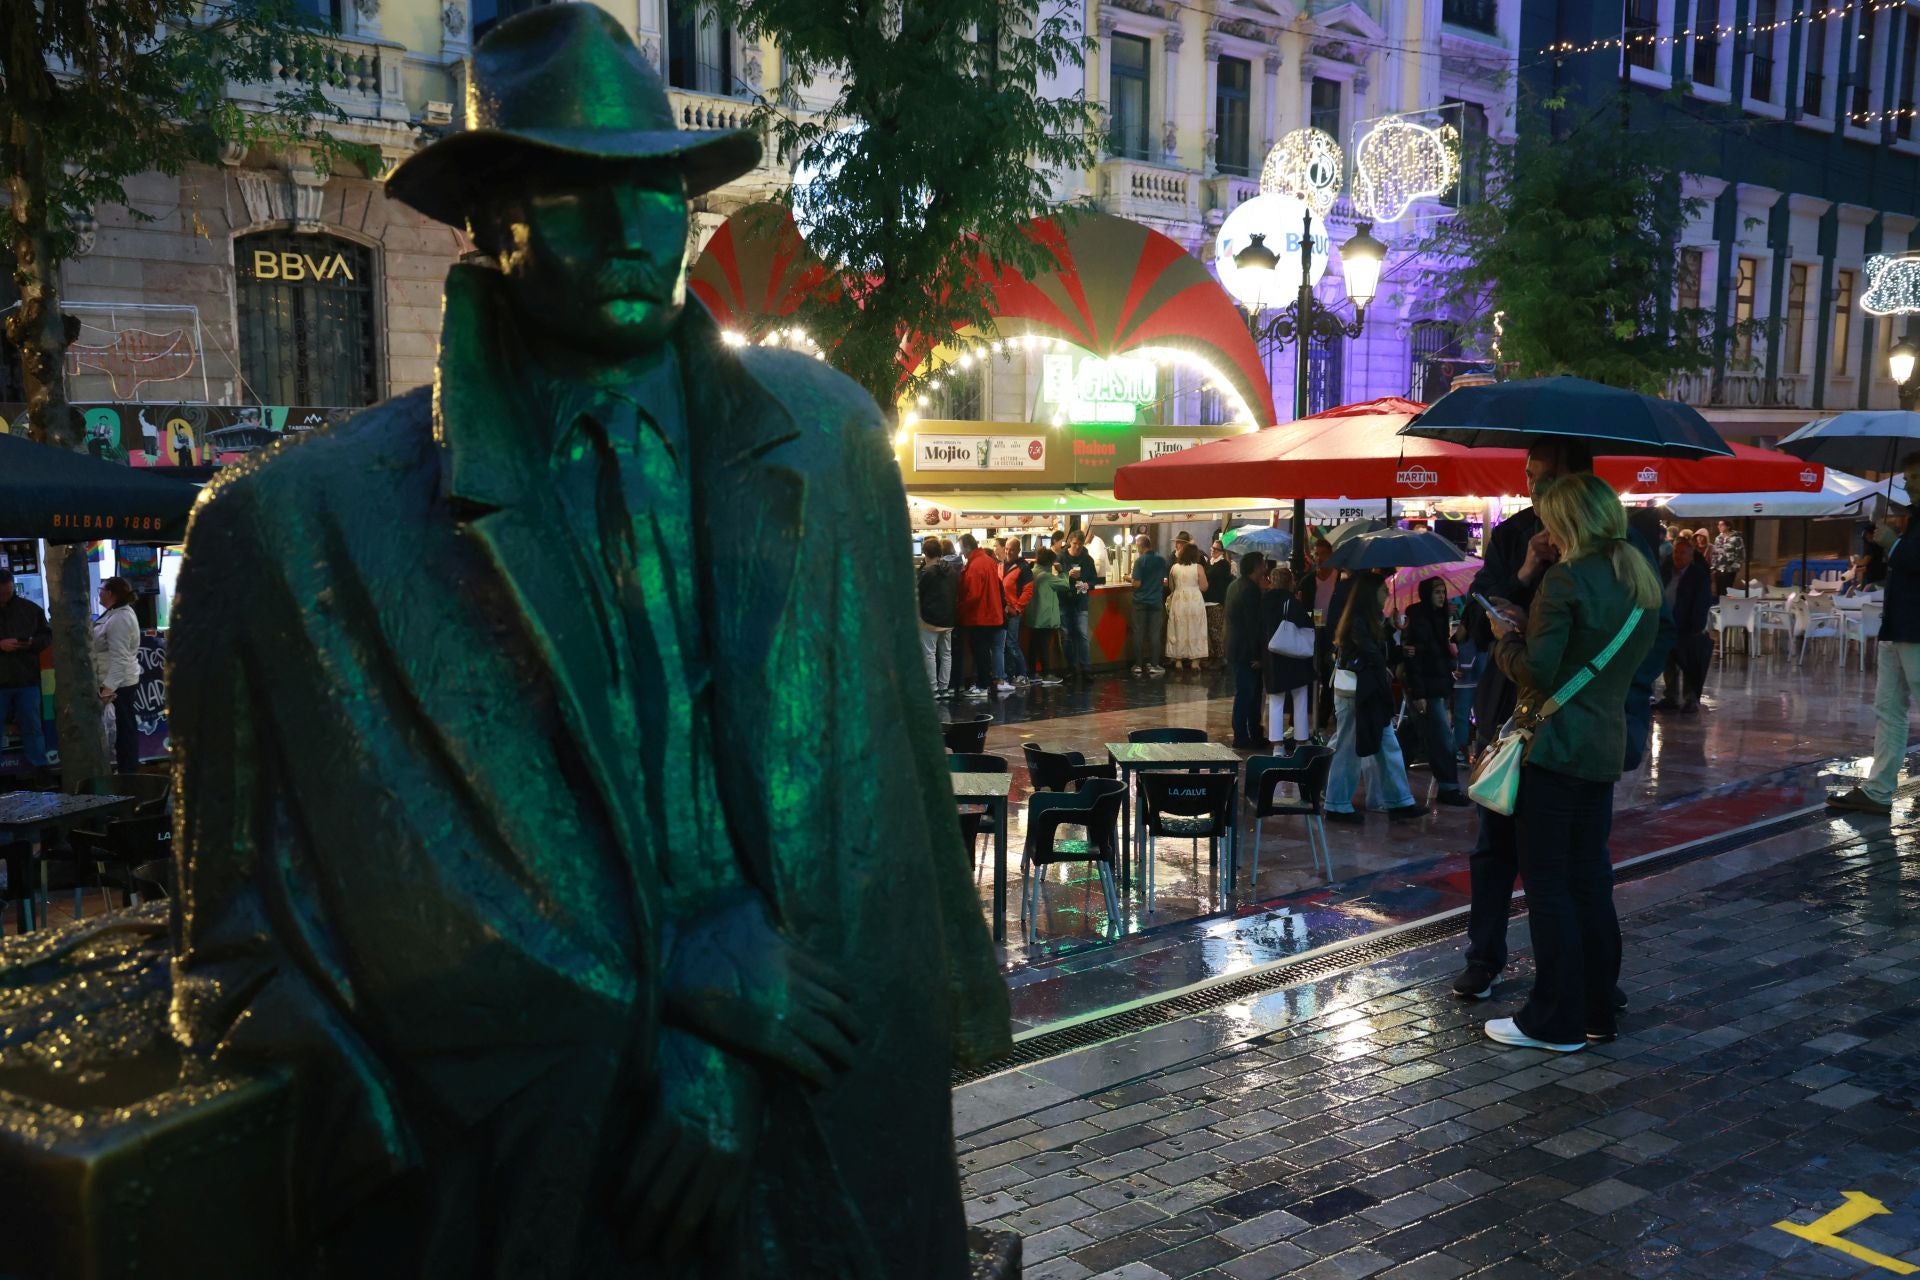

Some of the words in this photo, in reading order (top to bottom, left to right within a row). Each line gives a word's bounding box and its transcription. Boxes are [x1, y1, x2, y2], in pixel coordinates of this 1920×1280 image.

[254, 250, 354, 281] BBVA
[1155, 441, 1183, 452] Tinto
[924, 445, 971, 463] Mojito
[1398, 472, 1437, 482] MARTINI
[1339, 508, 1364, 517] PEPSI
[53, 514, 114, 528] BILBAO
[124, 516, 161, 530] 1886
[1168, 788, 1180, 796] LA
[1181, 788, 1207, 796] SALVE
[158, 831, 171, 841] LA
